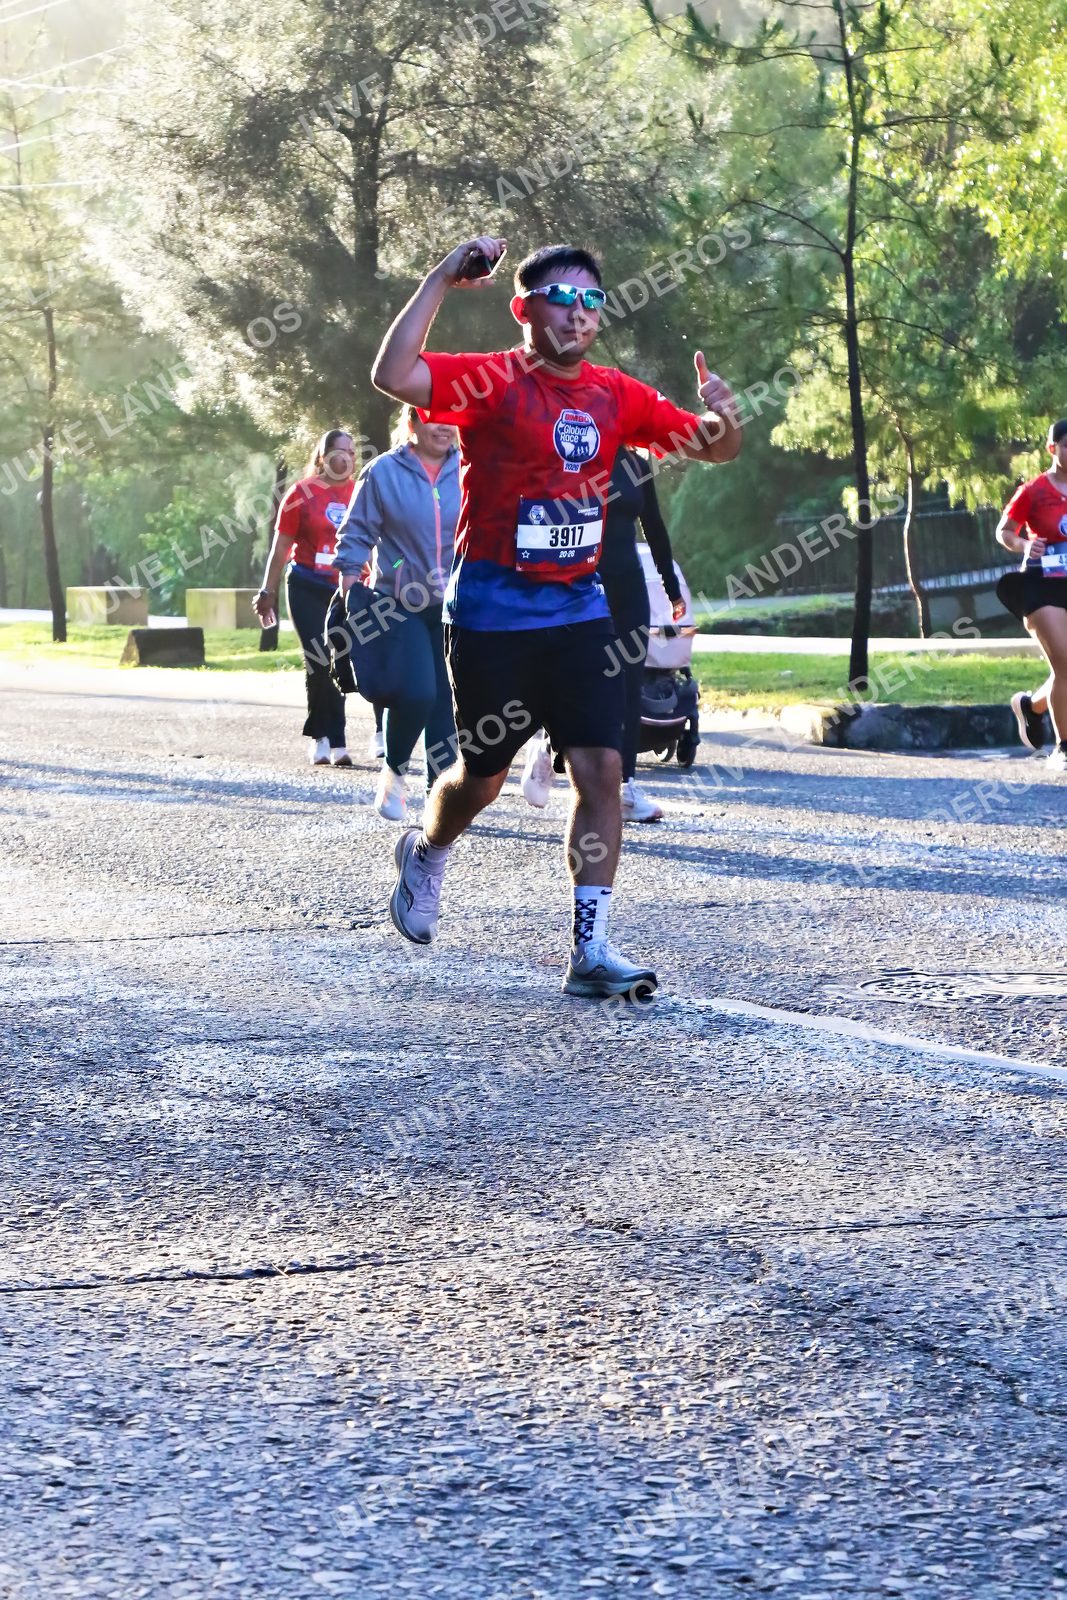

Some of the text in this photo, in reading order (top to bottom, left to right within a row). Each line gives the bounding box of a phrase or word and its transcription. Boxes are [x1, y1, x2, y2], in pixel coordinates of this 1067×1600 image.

[563, 424, 588, 436] Global
[560, 432, 579, 442] Race
[549, 525, 584, 547] 3917
